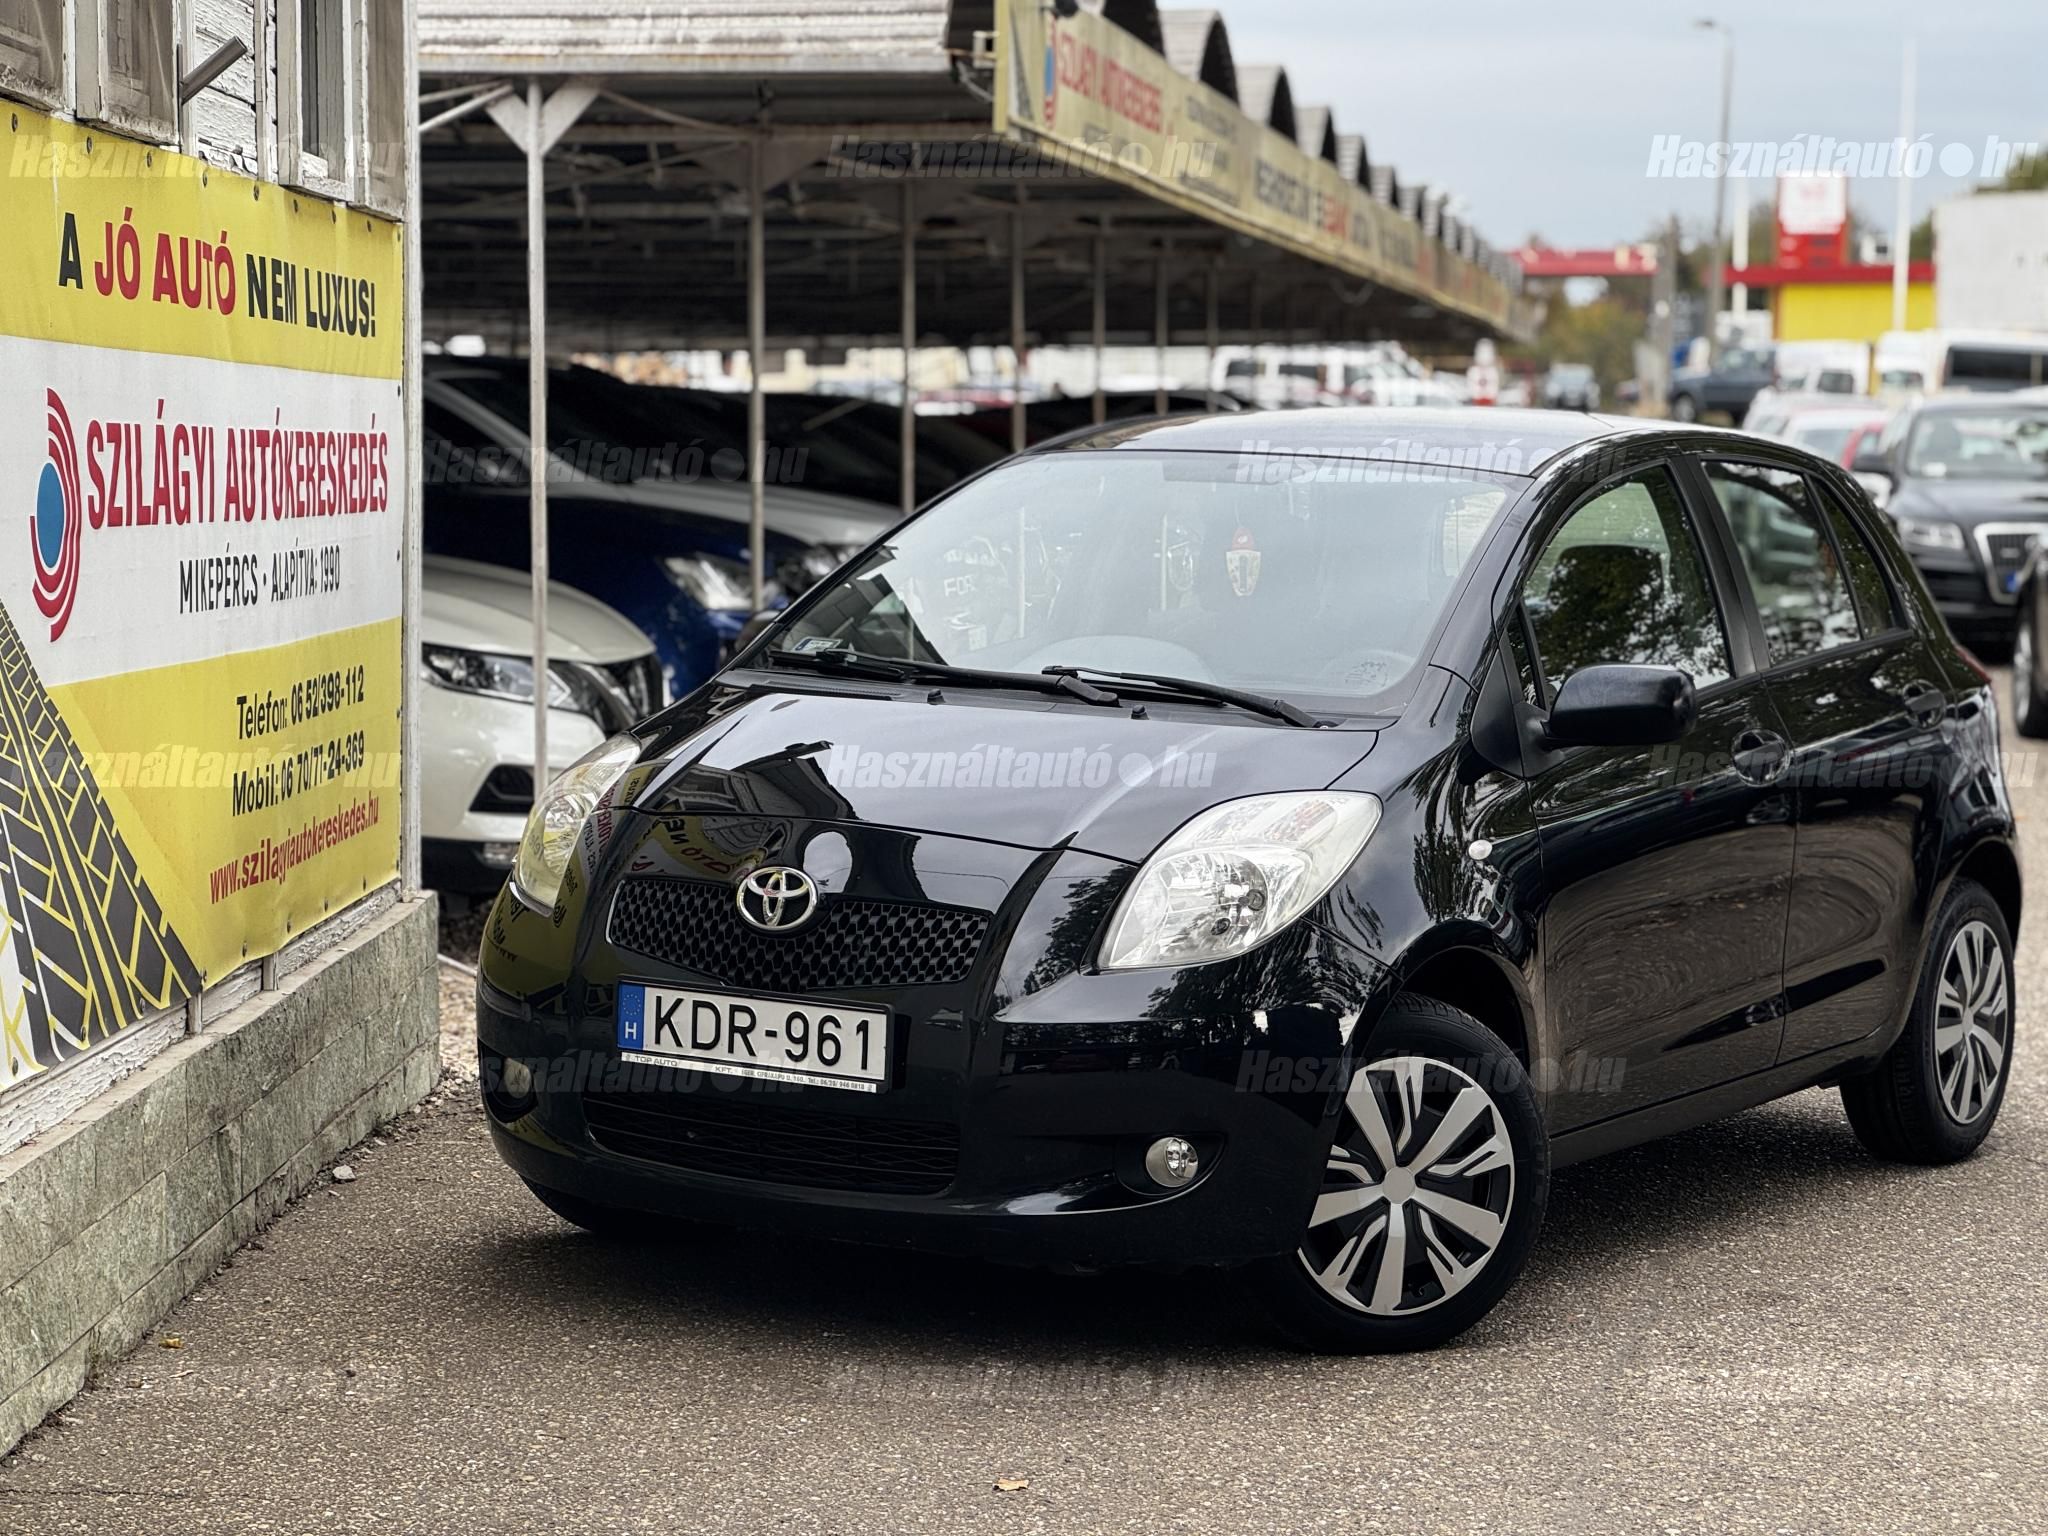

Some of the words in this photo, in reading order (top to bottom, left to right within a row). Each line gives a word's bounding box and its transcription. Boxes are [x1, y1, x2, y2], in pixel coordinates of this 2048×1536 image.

[58, 212, 83, 290] A
[94, 207, 140, 300] JÓ
[152, 230, 236, 316] AUTÓ
[246, 253, 298, 325] NEM
[304, 268, 376, 338] LUXUS!
[86, 398, 214, 530] SZILÁGYI
[223, 407, 388, 523] AUTÓKERESKEDÉS
[179, 542, 258, 614] MIKEPÉRCS
[270, 537, 318, 602] ALAPÍTVA:
[320, 544, 340, 593] 1990
[236, 690, 287, 740] Telefon:
[291, 682, 303, 725] 06
[305, 665, 364, 720] 52/398-112
[232, 763, 279, 817] Mobil:
[281, 757, 294, 801] 06
[297, 730, 364, 794] 70/77-24-369
[210, 790, 379, 905] www.szilagyiautokereskedes.hu
[624, 1021, 637, 1040] H
[635, 1055, 653, 1064] TOP
[654, 1058, 678, 1067] AUTO
[654, 994, 870, 1071] KDR-961
